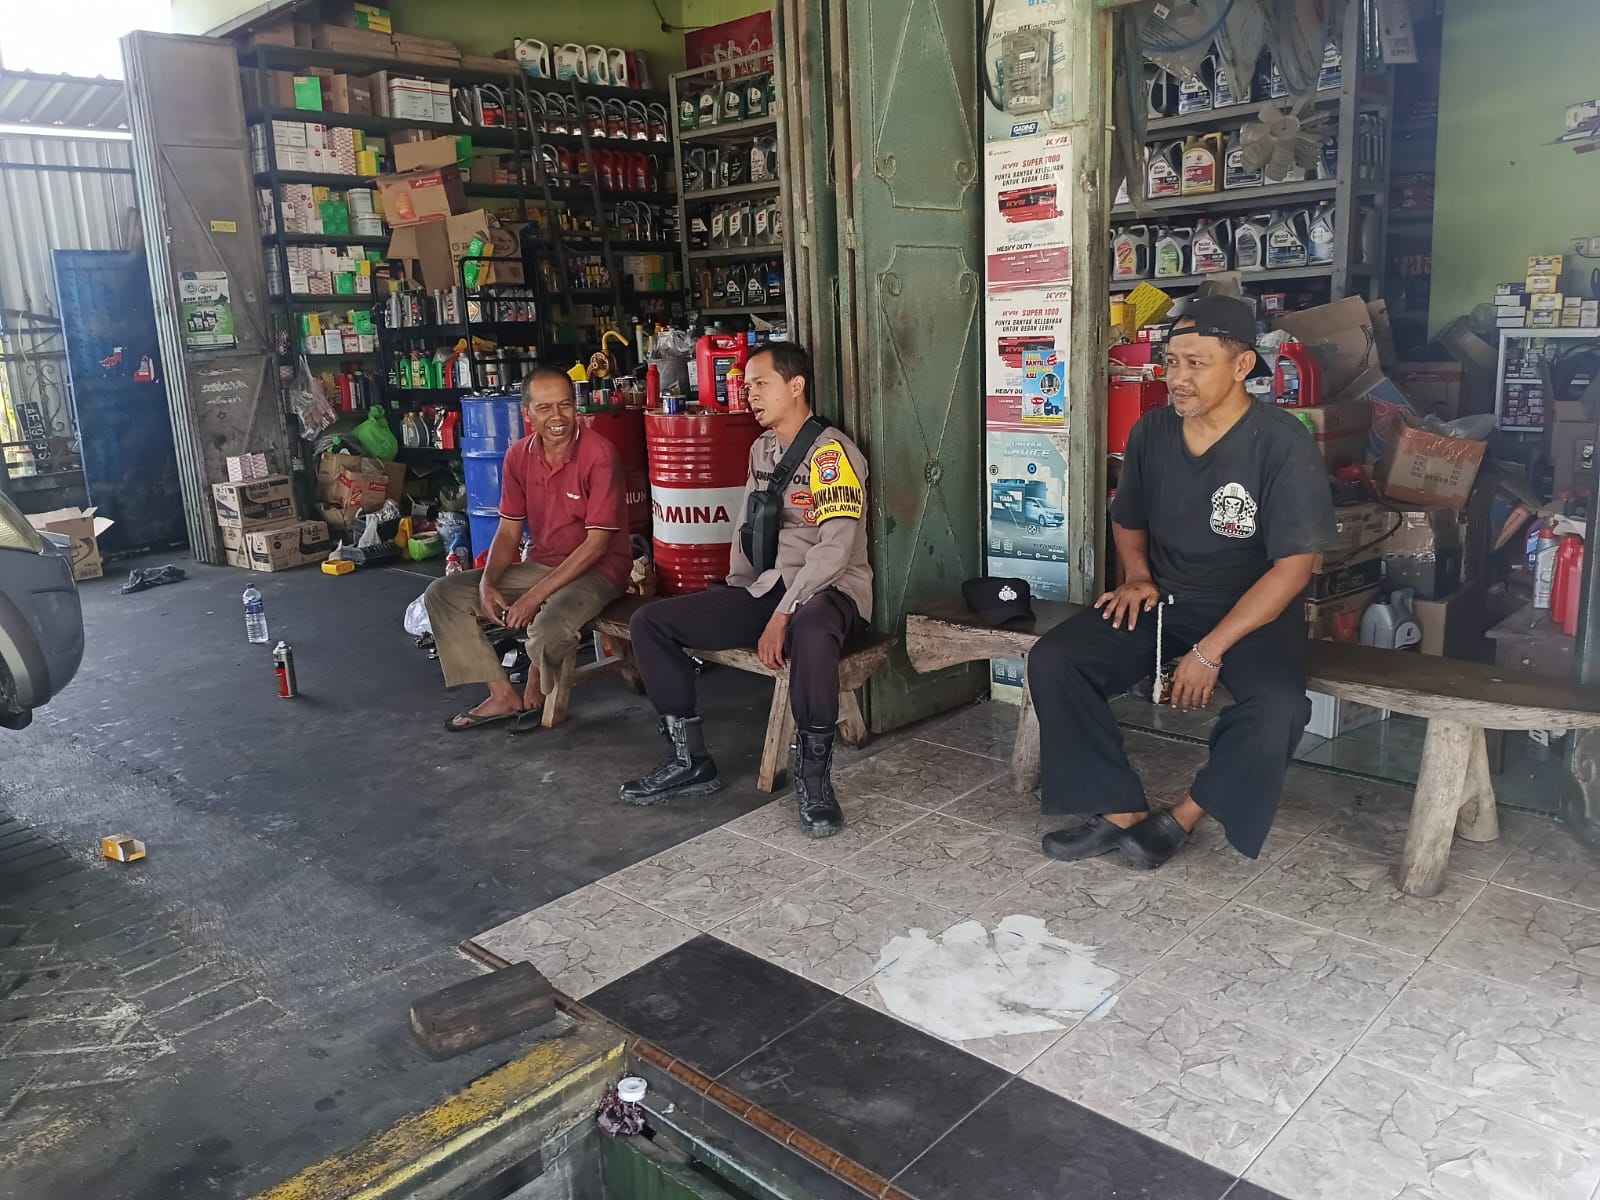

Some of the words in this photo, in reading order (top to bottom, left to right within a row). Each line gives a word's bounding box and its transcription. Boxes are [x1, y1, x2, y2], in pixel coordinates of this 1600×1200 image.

[1048, 18, 1067, 27] Power
[1022, 156, 1043, 168] SUPER
[995, 172, 1011, 181] PUNYA
[1013, 169, 1033, 178] BANYAK
[1002, 177, 1020, 186] UNTUK
[996, 244, 1015, 252] HEAVY
